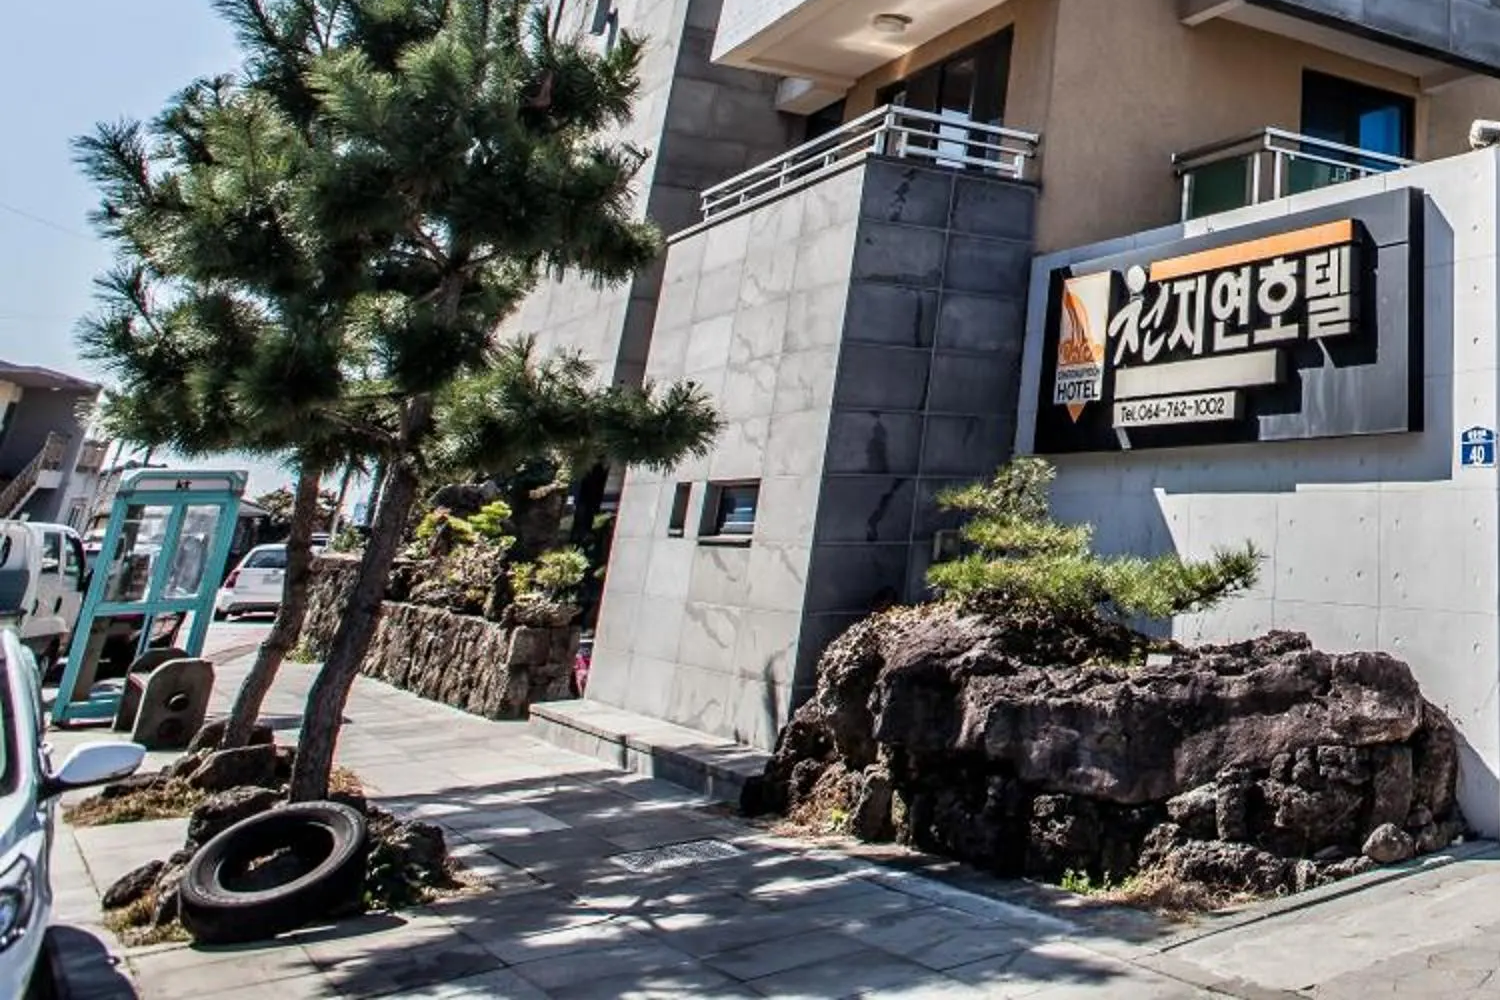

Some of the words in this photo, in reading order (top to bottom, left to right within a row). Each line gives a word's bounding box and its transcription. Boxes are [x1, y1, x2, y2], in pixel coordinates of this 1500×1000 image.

[1108, 247, 1351, 366] 천지연호텔
[1057, 379, 1099, 400] HOTEL
[1470, 445, 1485, 464] 40
